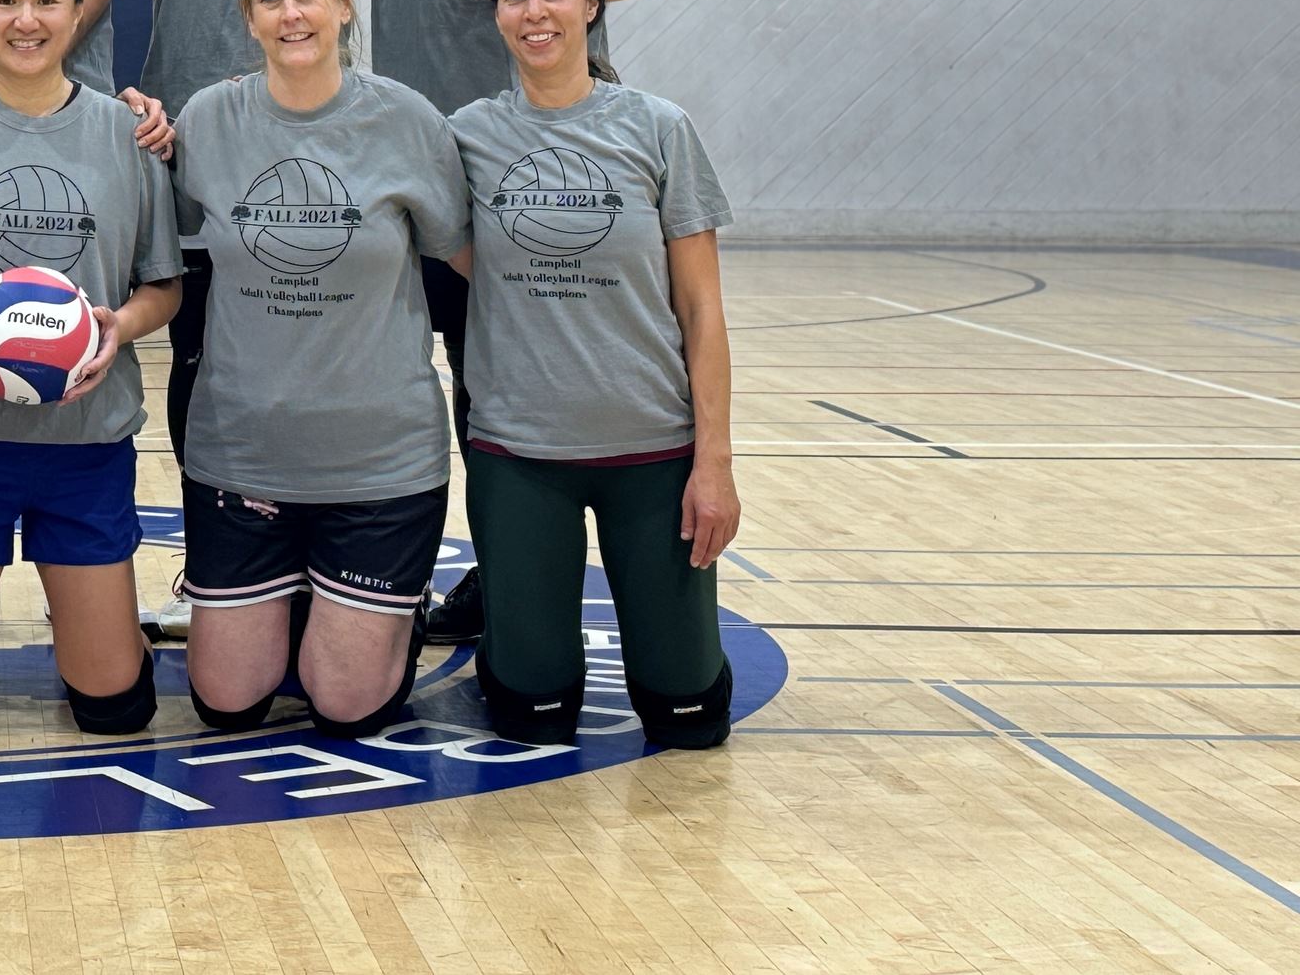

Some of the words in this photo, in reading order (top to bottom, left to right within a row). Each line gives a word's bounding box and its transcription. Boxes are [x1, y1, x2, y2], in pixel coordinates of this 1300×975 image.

[510, 193, 555, 207] FALL
[555, 193, 599, 208] 2024
[36, 215, 74, 231] 2024
[253, 209, 295, 223] FALL
[299, 210, 338, 223] 2024
[529, 257, 582, 270] Campbell
[270, 275, 319, 288] Campbell
[501, 272, 524, 282] Adult
[526, 273, 579, 285] Volleyball
[581, 274, 620, 287] League
[238, 286, 264, 299] Adult
[266, 290, 317, 304] Volleyball
[318, 292, 355, 303] League
[528, 287, 588, 300] Champions
[267, 305, 324, 319] Champions
[8, 311, 66, 334] molten
